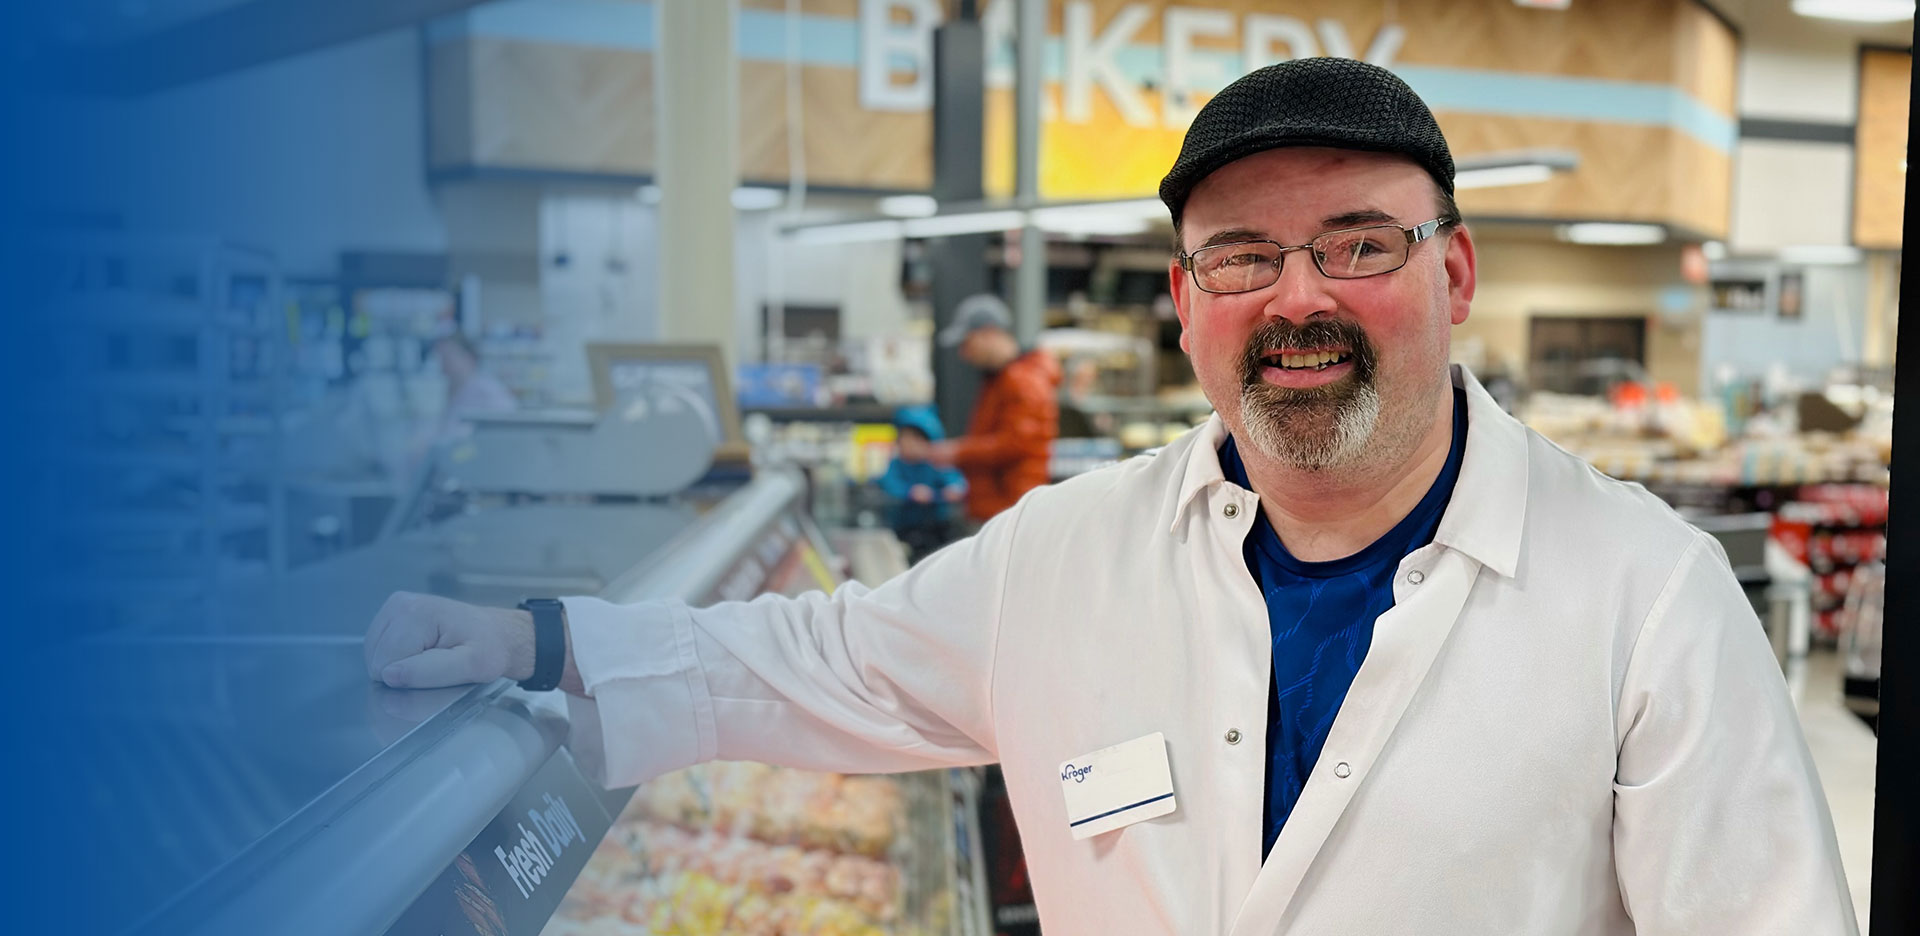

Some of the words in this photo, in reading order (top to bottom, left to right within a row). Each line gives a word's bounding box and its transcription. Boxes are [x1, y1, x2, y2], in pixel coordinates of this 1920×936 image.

[1061, 764, 1093, 783] Kroger
[494, 822, 554, 899] Fresh
[528, 792, 586, 858] Daily
